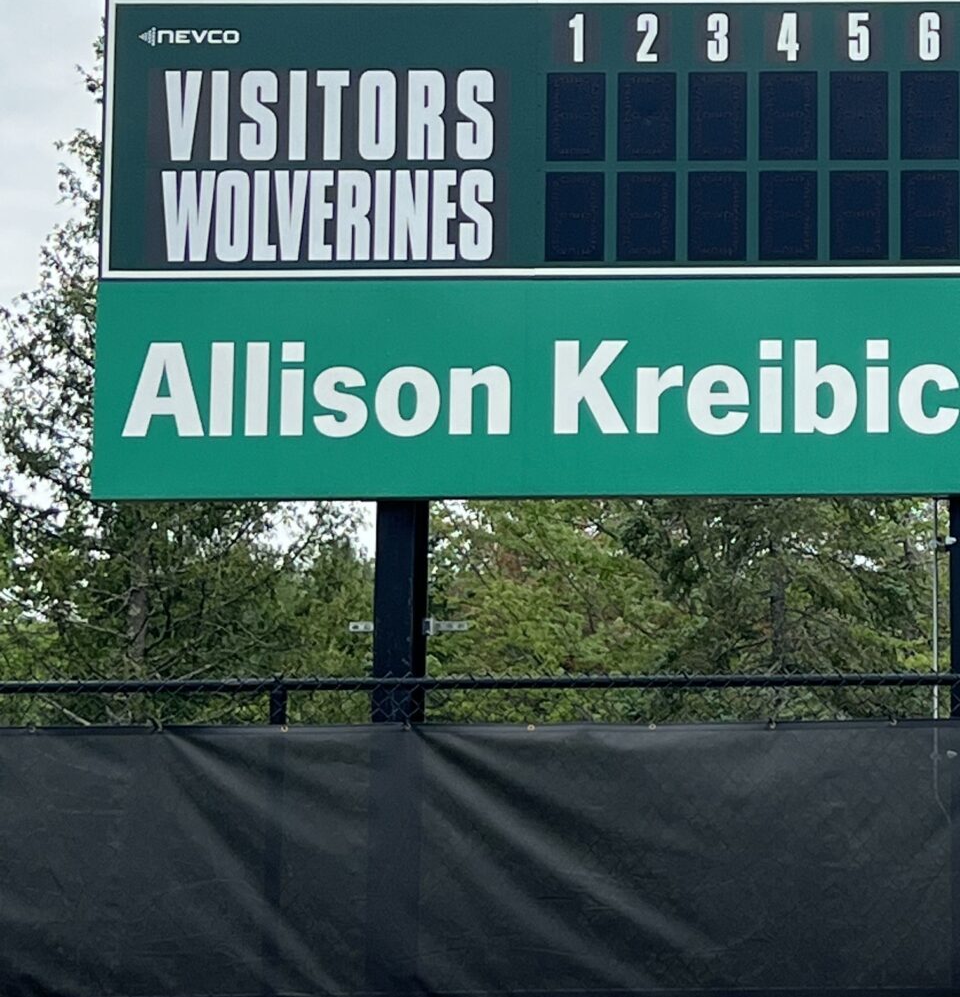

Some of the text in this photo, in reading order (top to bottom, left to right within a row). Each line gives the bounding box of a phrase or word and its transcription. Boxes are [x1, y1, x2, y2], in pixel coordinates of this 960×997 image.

[157, 29, 240, 44] NEVCO
[568, 13, 584, 63] 1
[636, 13, 658, 62] 2
[707, 13, 729, 62] 3
[777, 12, 800, 62] 4
[848, 12, 870, 61] 5
[919, 11, 940, 61] 6
[165, 70, 494, 161] VISITORS
[161, 169, 494, 262] WOLVERINES
[121, 341, 511, 438] Allison
